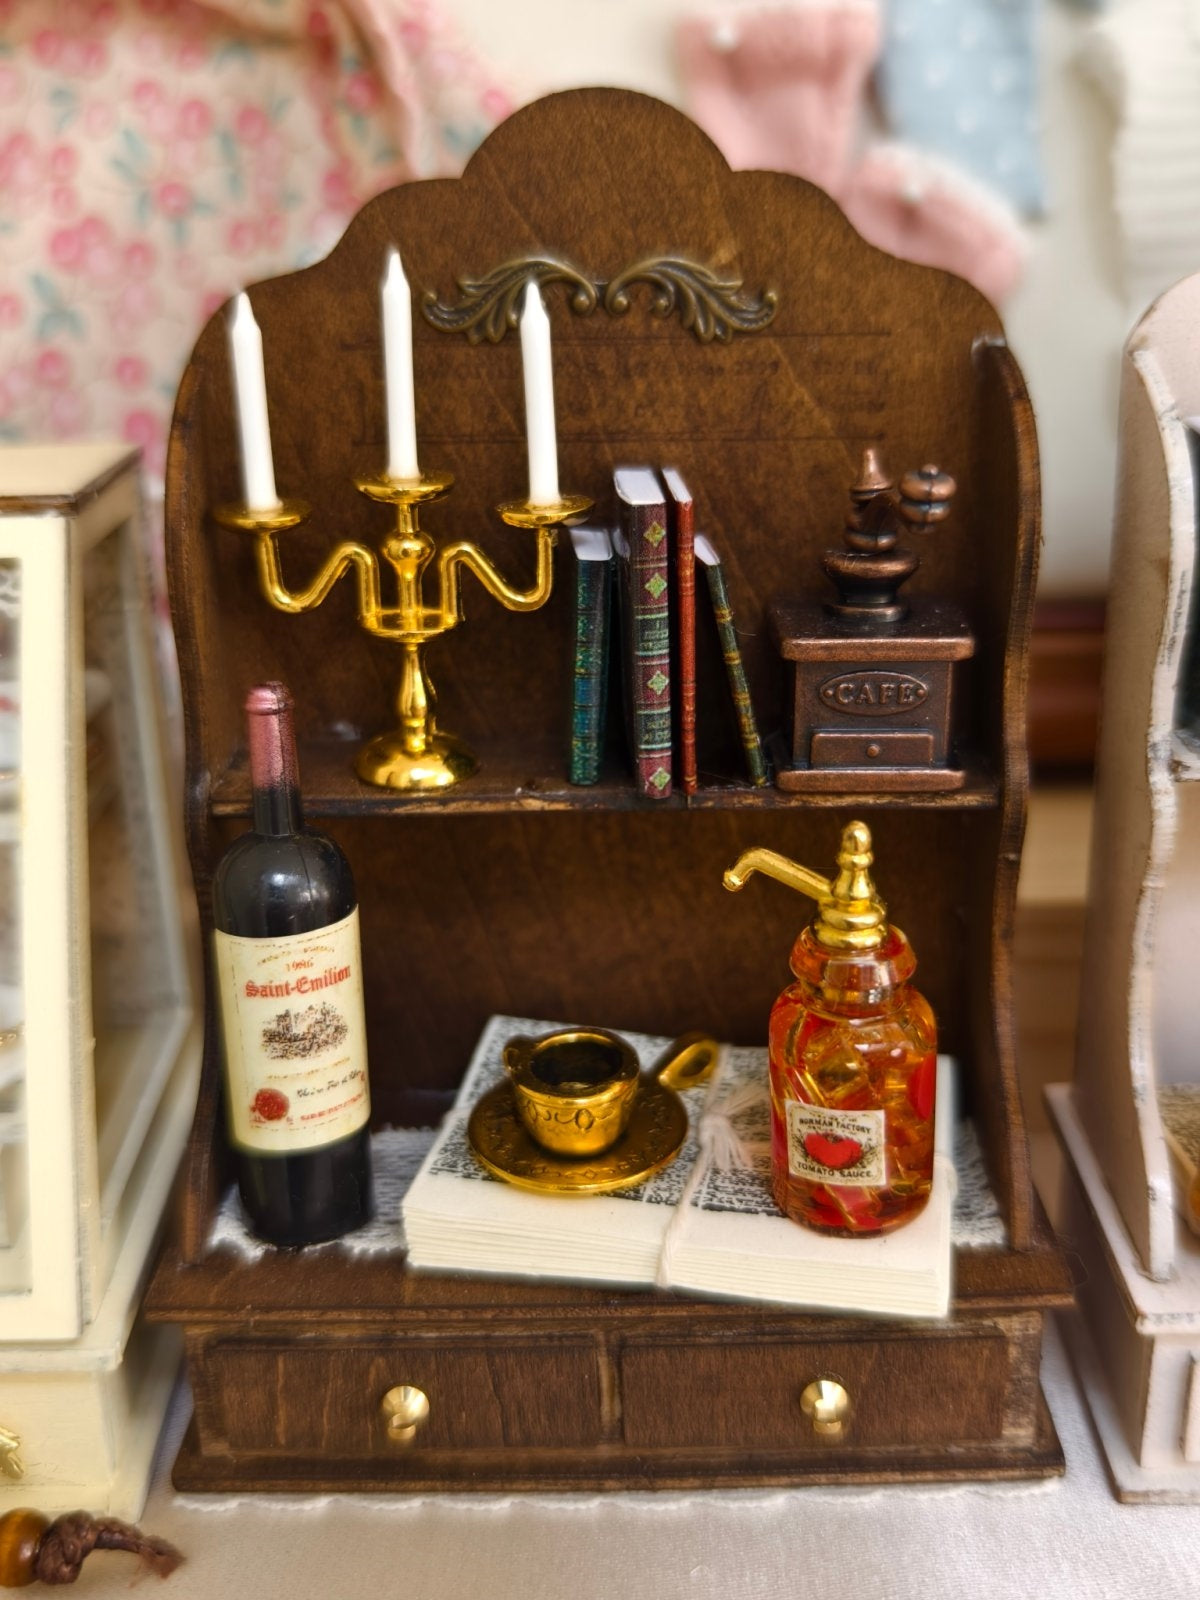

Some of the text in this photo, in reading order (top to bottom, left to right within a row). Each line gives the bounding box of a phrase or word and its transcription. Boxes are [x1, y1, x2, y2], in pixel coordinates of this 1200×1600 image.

[834, 683, 914, 705] CAFE
[244, 964, 351, 998] Saint-Emilion
[836, 1121, 872, 1134] FACTORY
[796, 1160, 872, 1178] TOMATO SAUCE
